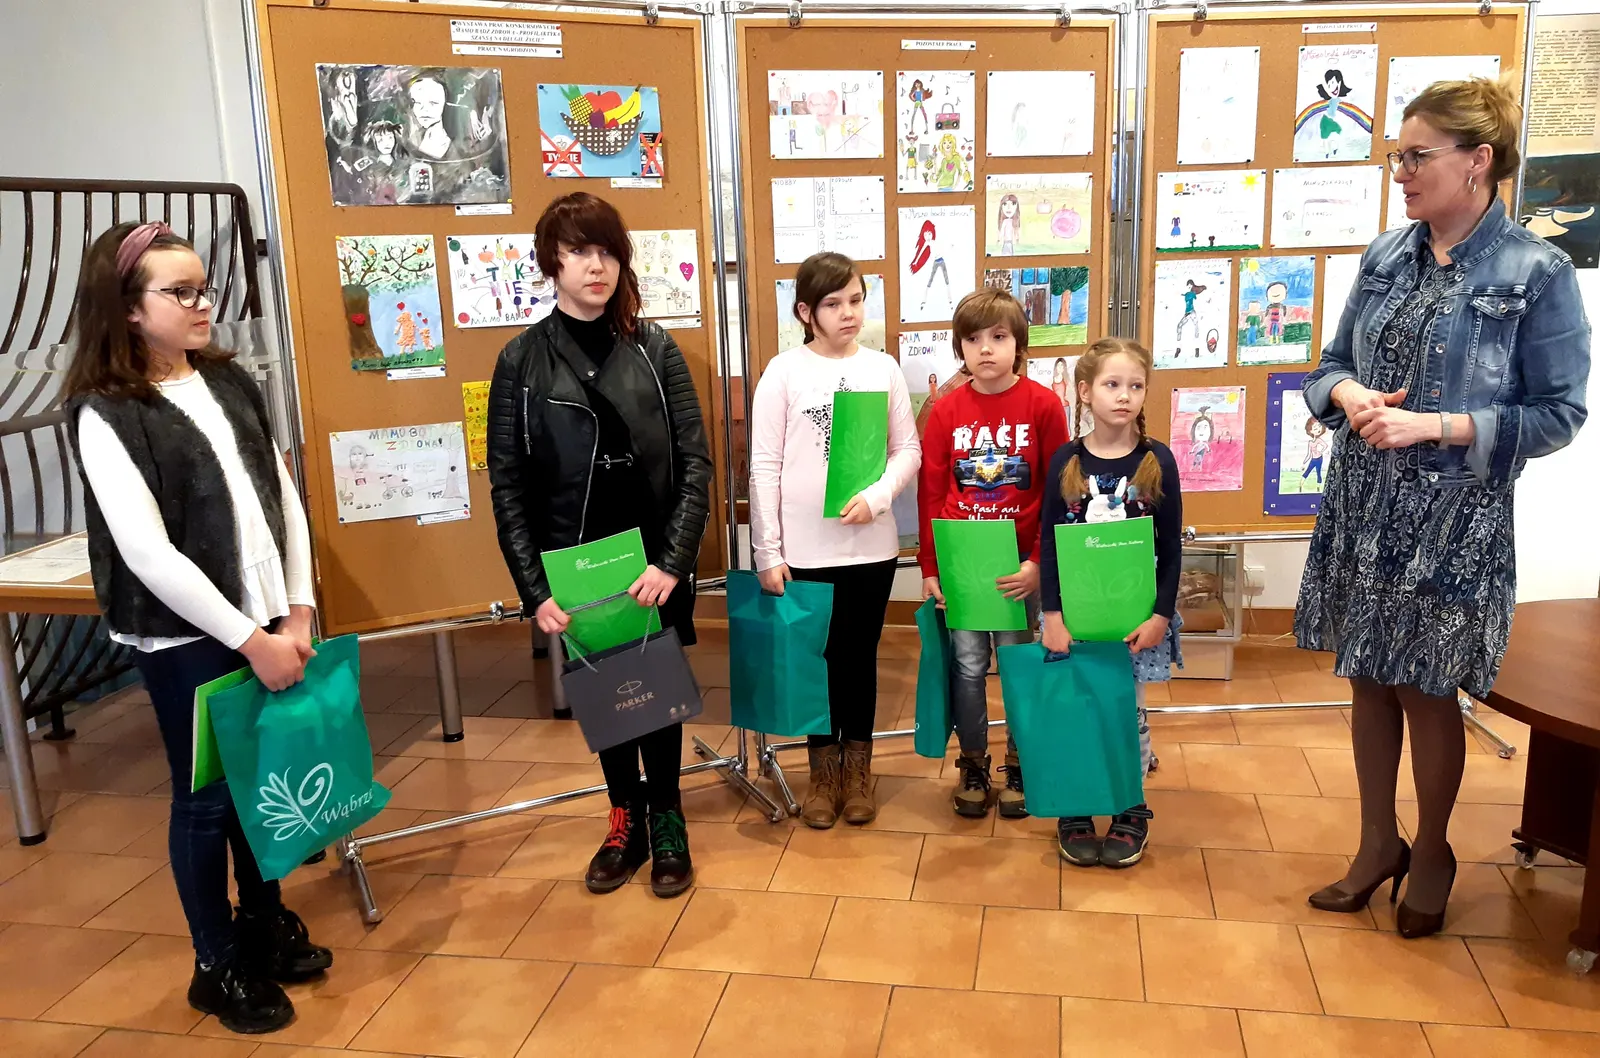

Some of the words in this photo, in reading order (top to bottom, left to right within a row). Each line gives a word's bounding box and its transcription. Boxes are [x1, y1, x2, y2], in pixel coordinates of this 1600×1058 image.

[545, 153, 579, 163] TYIE
[952, 422, 1030, 451] RACE
[1001, 504, 1020, 513] and
[615, 691, 655, 711] PARKER
